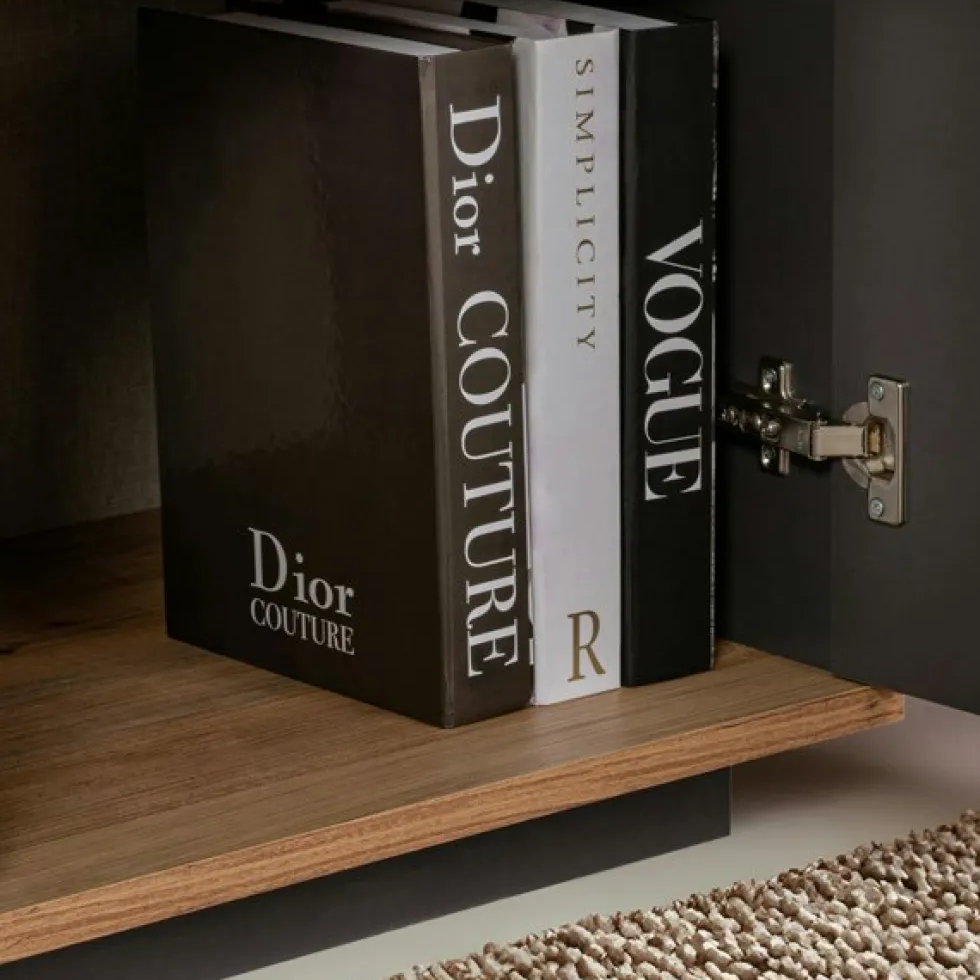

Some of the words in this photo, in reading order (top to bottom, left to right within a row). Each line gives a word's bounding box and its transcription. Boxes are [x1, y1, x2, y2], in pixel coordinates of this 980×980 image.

[448, 95, 502, 256] Dior
[575, 58, 595, 351] SIMPLICITY
[643, 219, 704, 501] VOGUE
[457, 290, 519, 678] COUTURE
[249, 527, 355, 617] Dior
[250, 597, 356, 656] COUTURE
[566, 609, 606, 682] R
